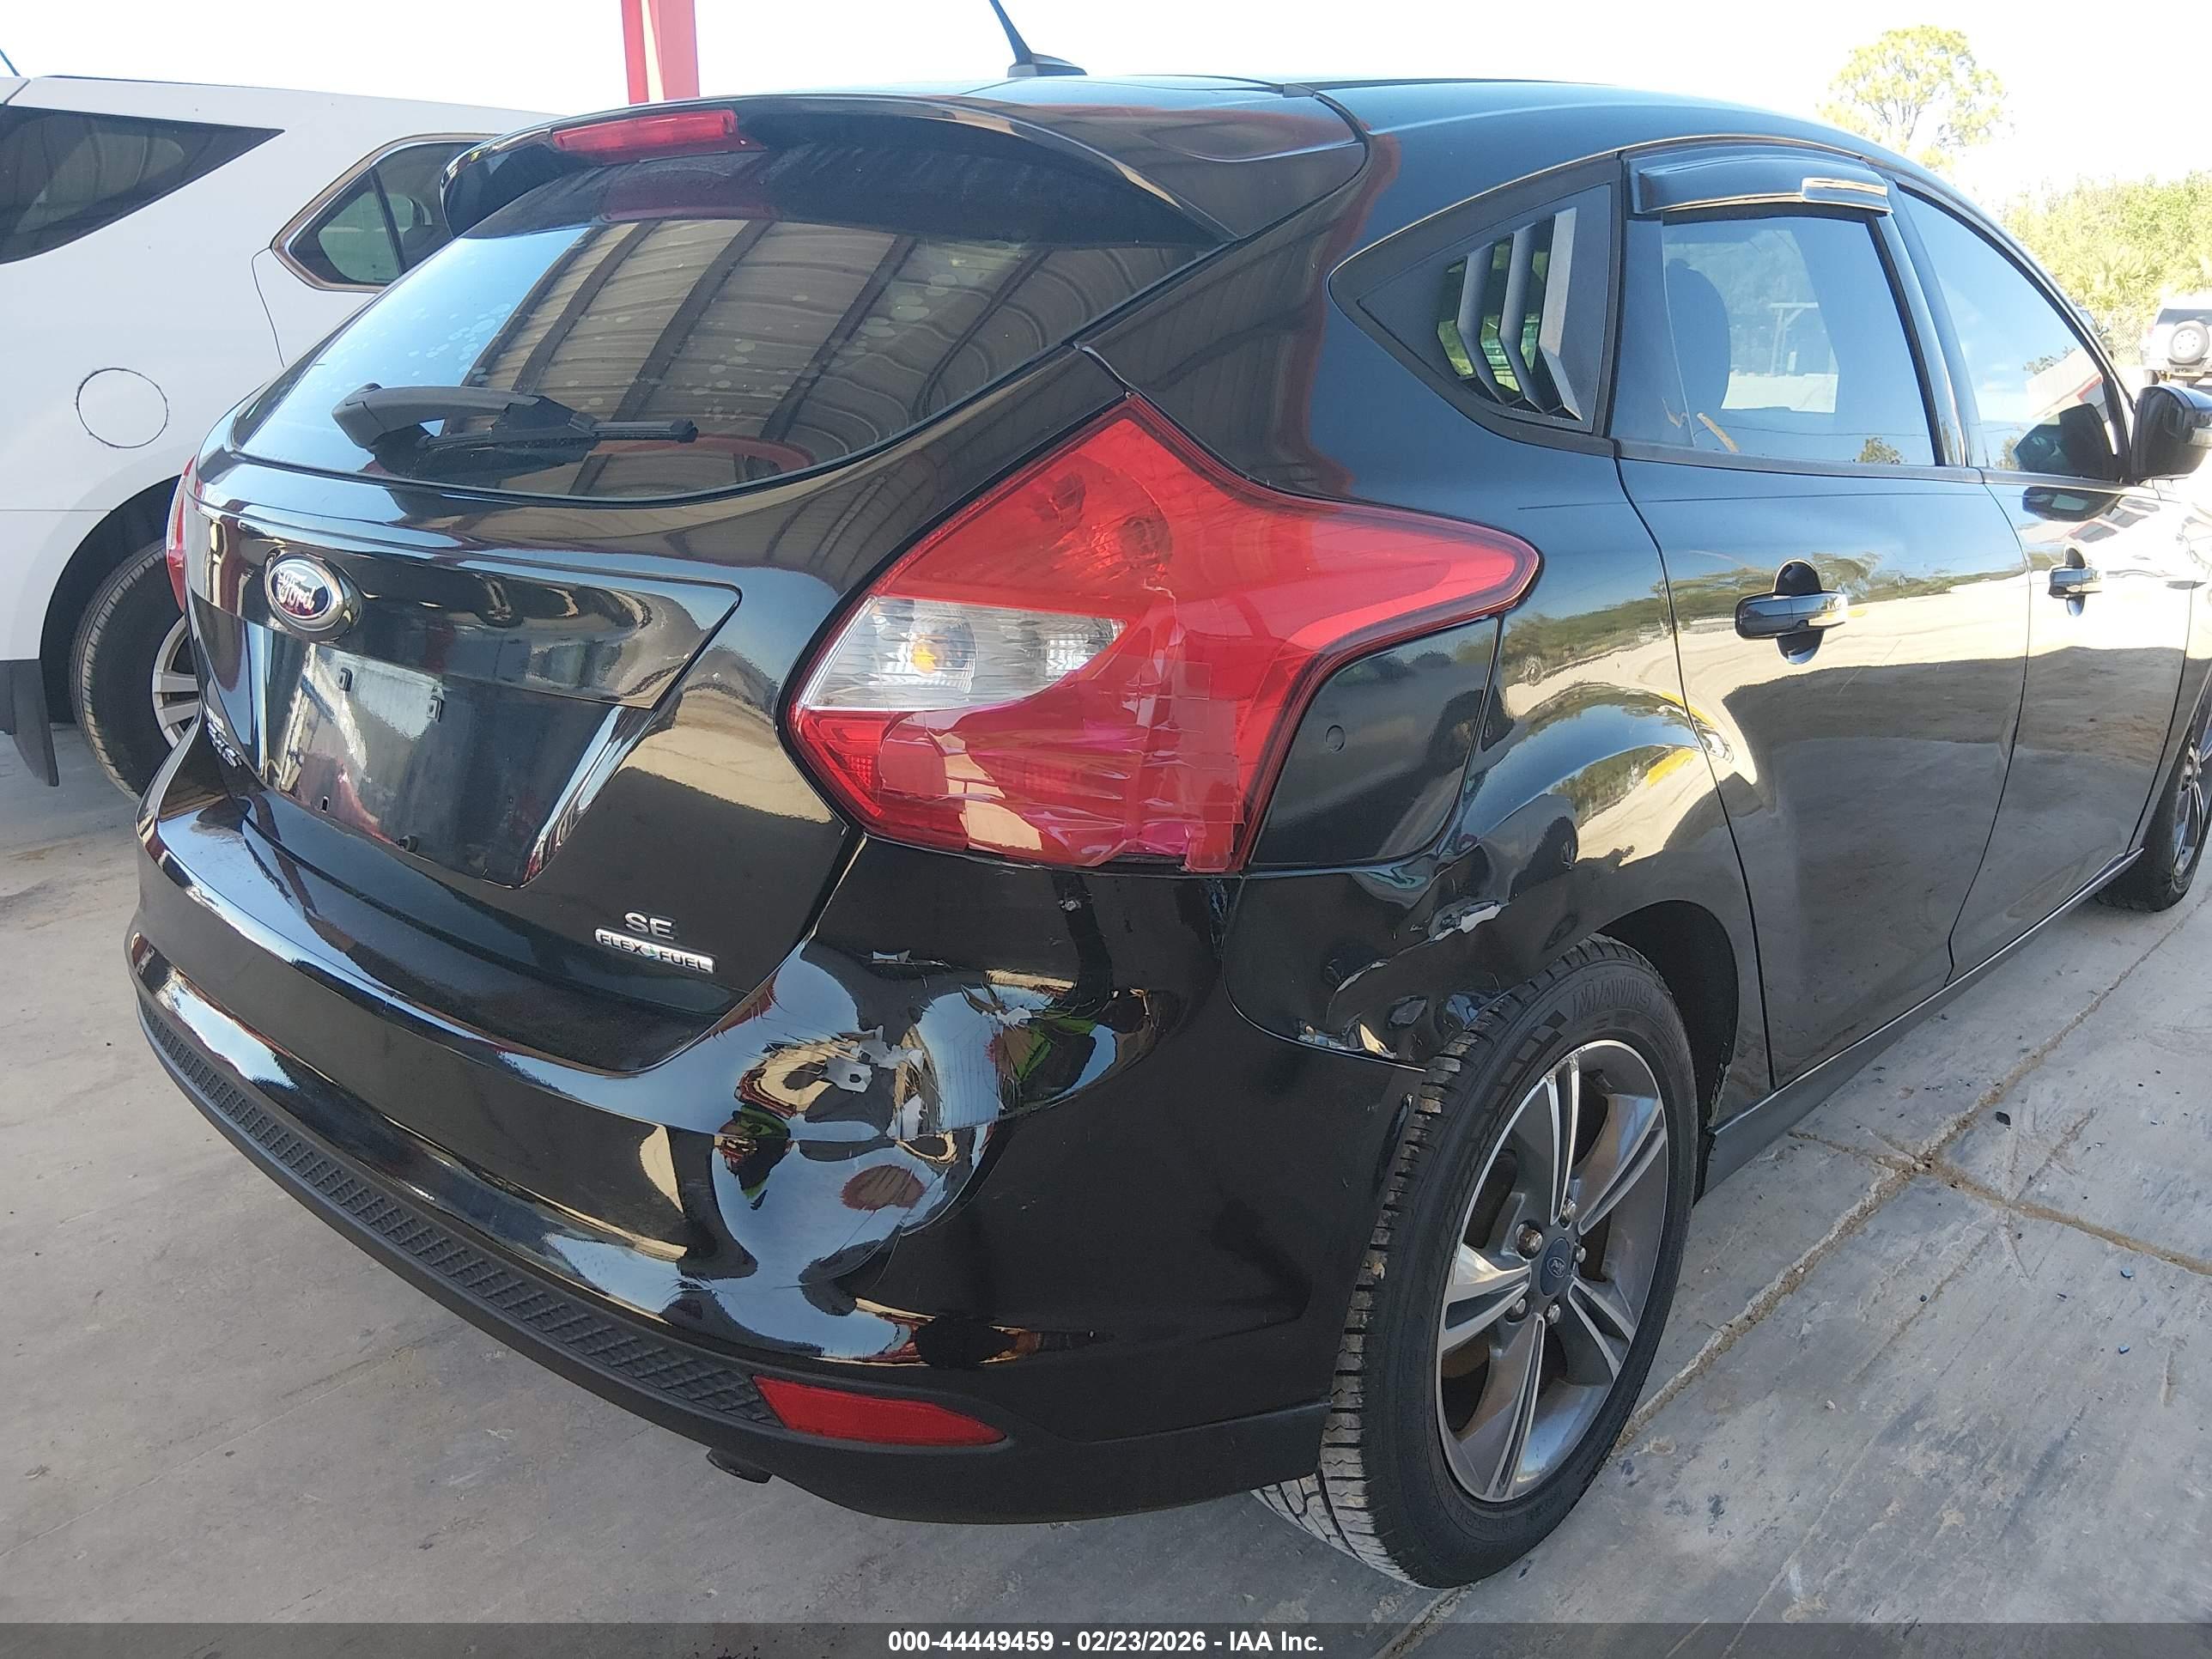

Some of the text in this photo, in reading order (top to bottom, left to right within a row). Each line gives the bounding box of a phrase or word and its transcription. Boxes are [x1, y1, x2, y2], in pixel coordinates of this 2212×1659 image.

[276, 568, 316, 611] Ford
[624, 912, 674, 939] SE
[600, 934, 709, 971] FLEX FUEL
